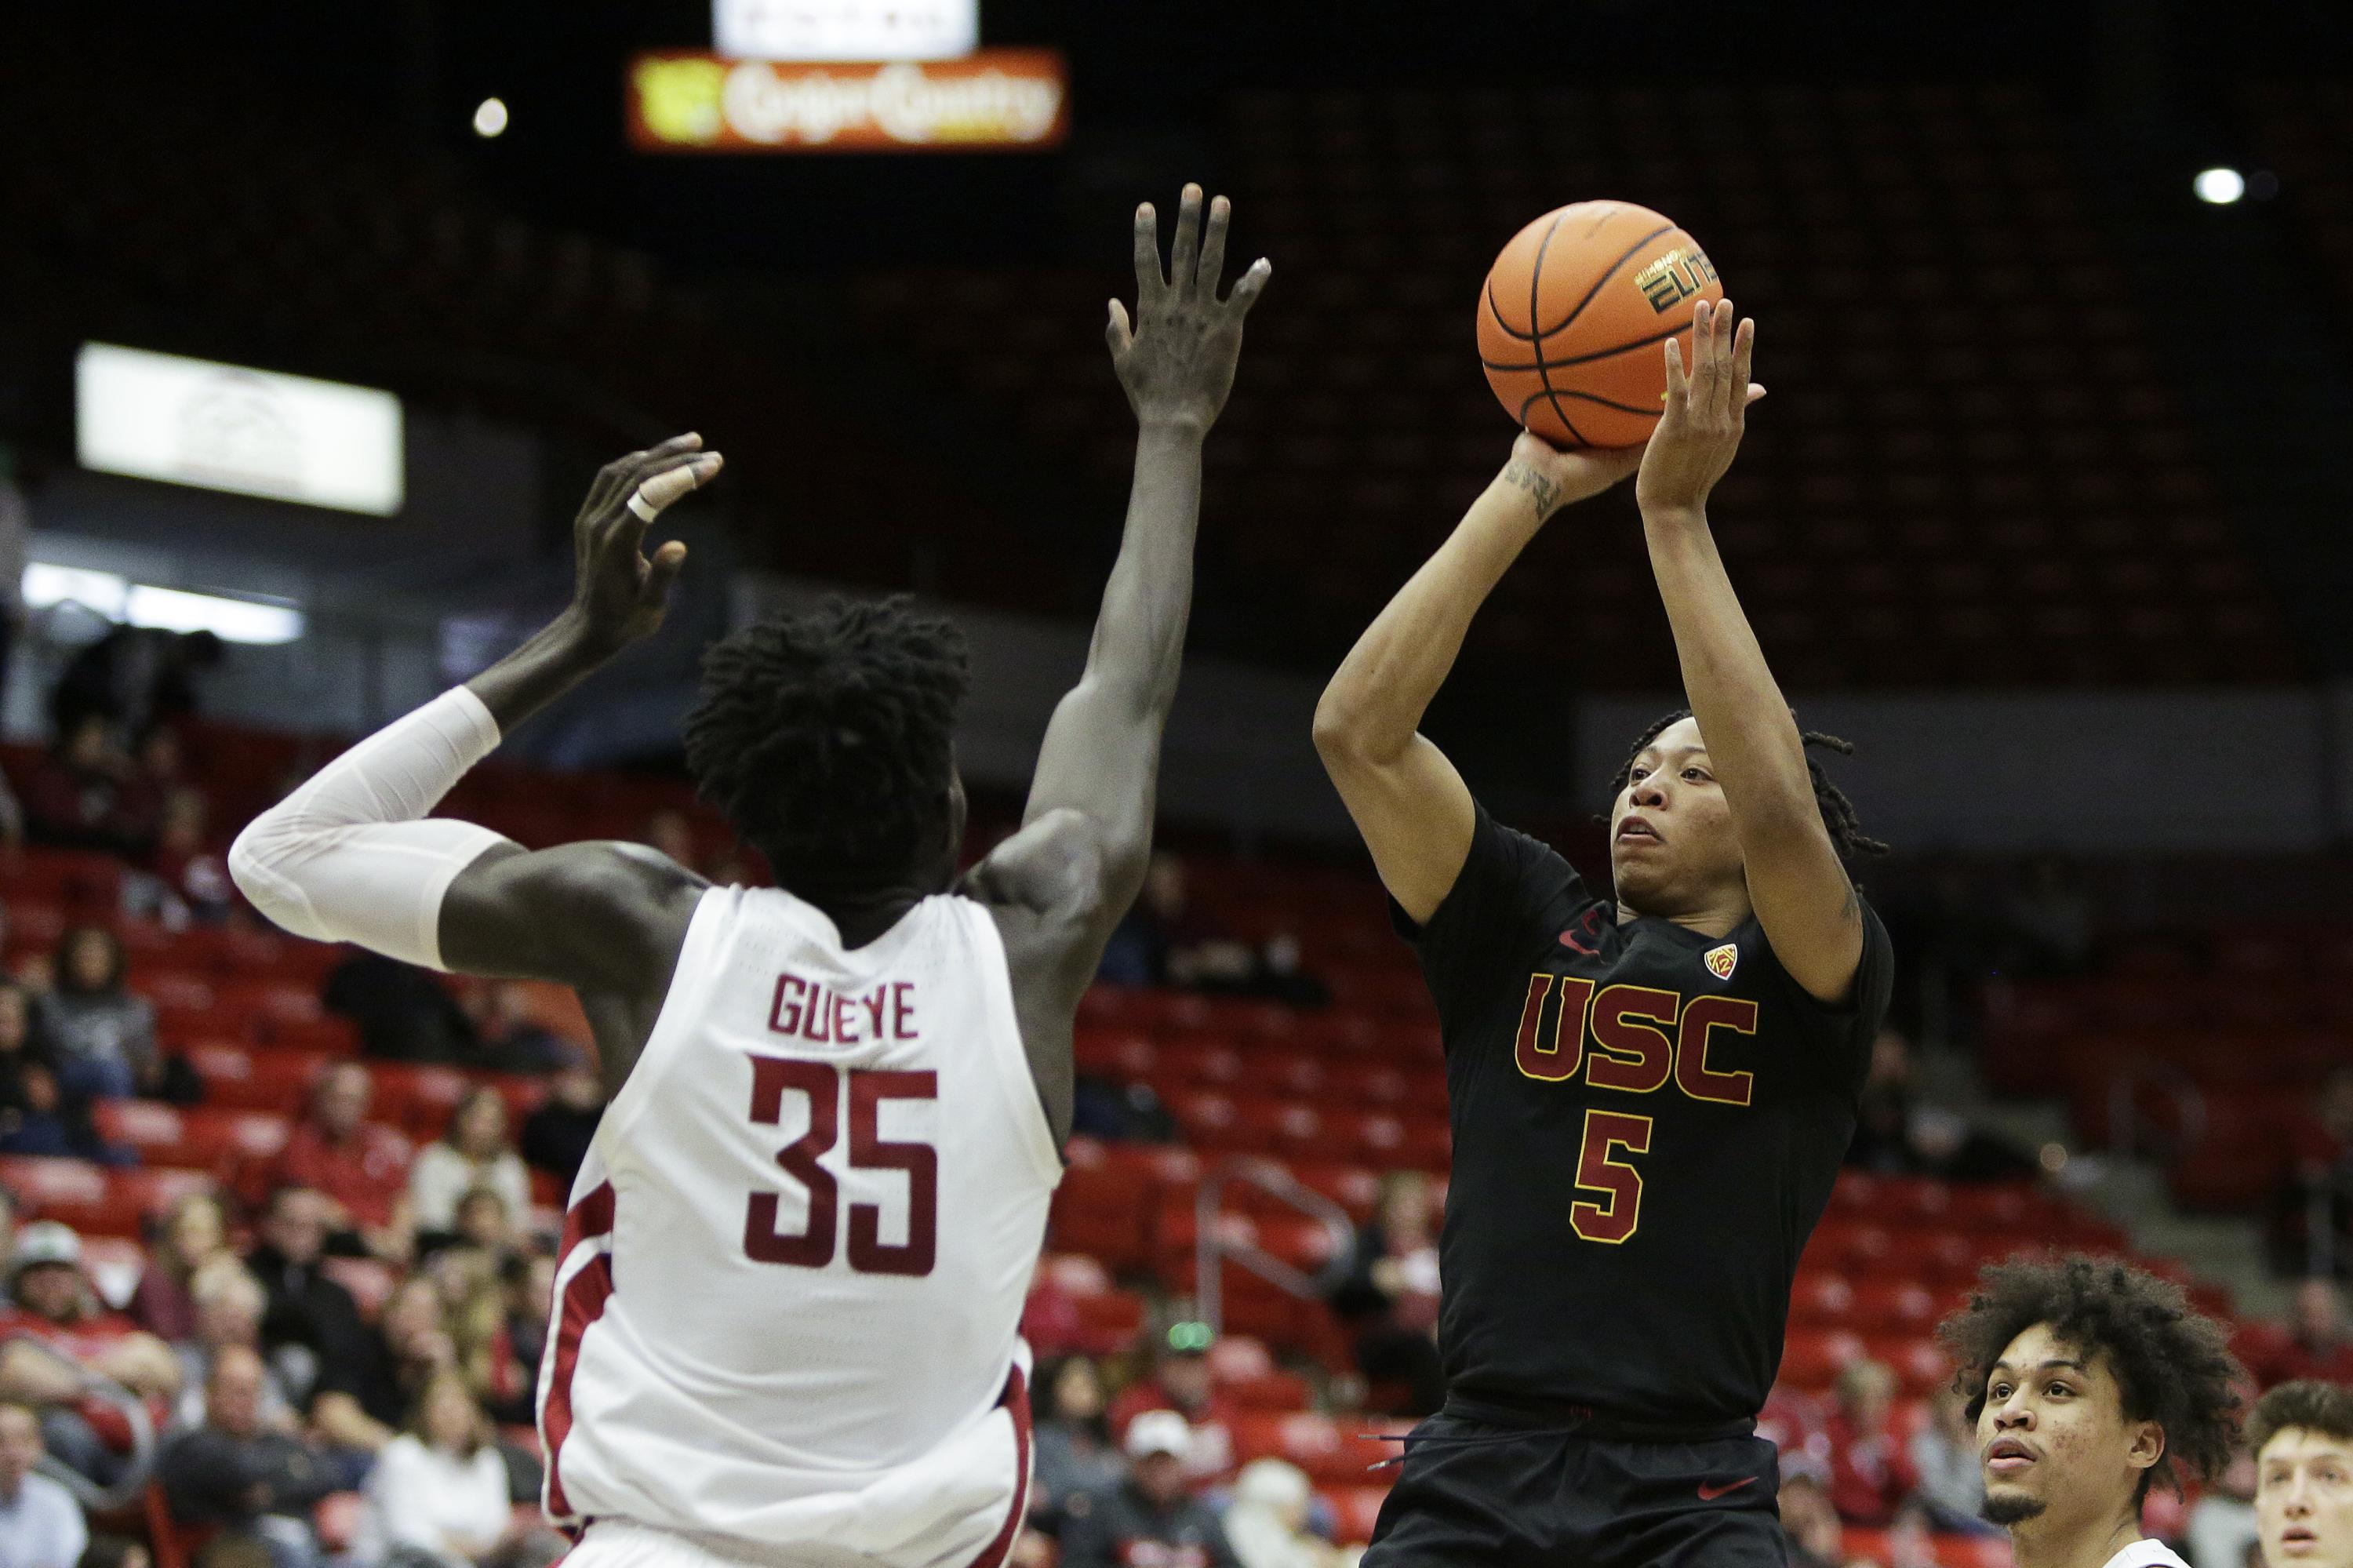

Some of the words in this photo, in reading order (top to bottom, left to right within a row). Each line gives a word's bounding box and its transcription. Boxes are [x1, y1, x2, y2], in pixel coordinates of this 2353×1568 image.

[768, 973, 918, 1043] GUEYE
[1515, 973, 1758, 1108] USC
[744, 1053, 938, 1278] 35
[1569, 1108, 1653, 1245] 5
